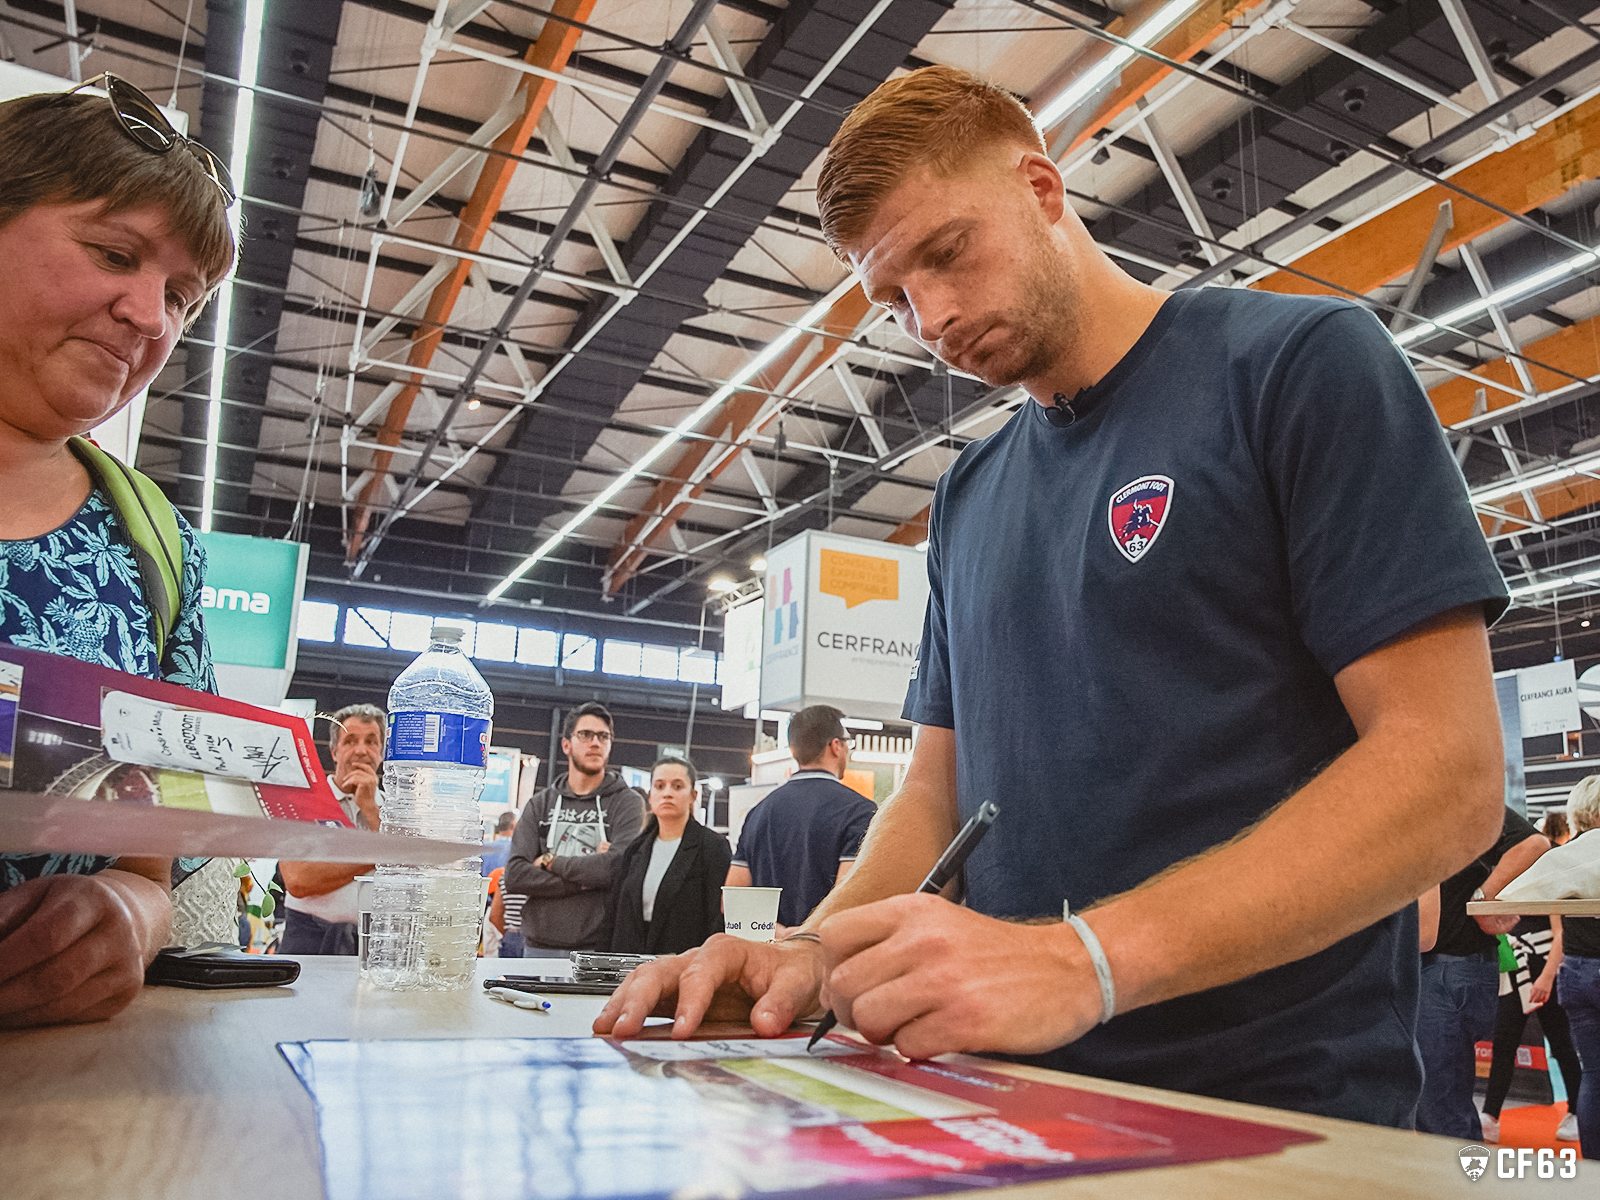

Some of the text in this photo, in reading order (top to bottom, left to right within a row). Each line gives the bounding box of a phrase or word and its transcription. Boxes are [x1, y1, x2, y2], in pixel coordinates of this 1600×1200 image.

[1116, 481, 1167, 503] CLERMONT FOOT
[1129, 541, 1144, 553] 63
[1520, 687, 1572, 702] CERFRANCE AURA
